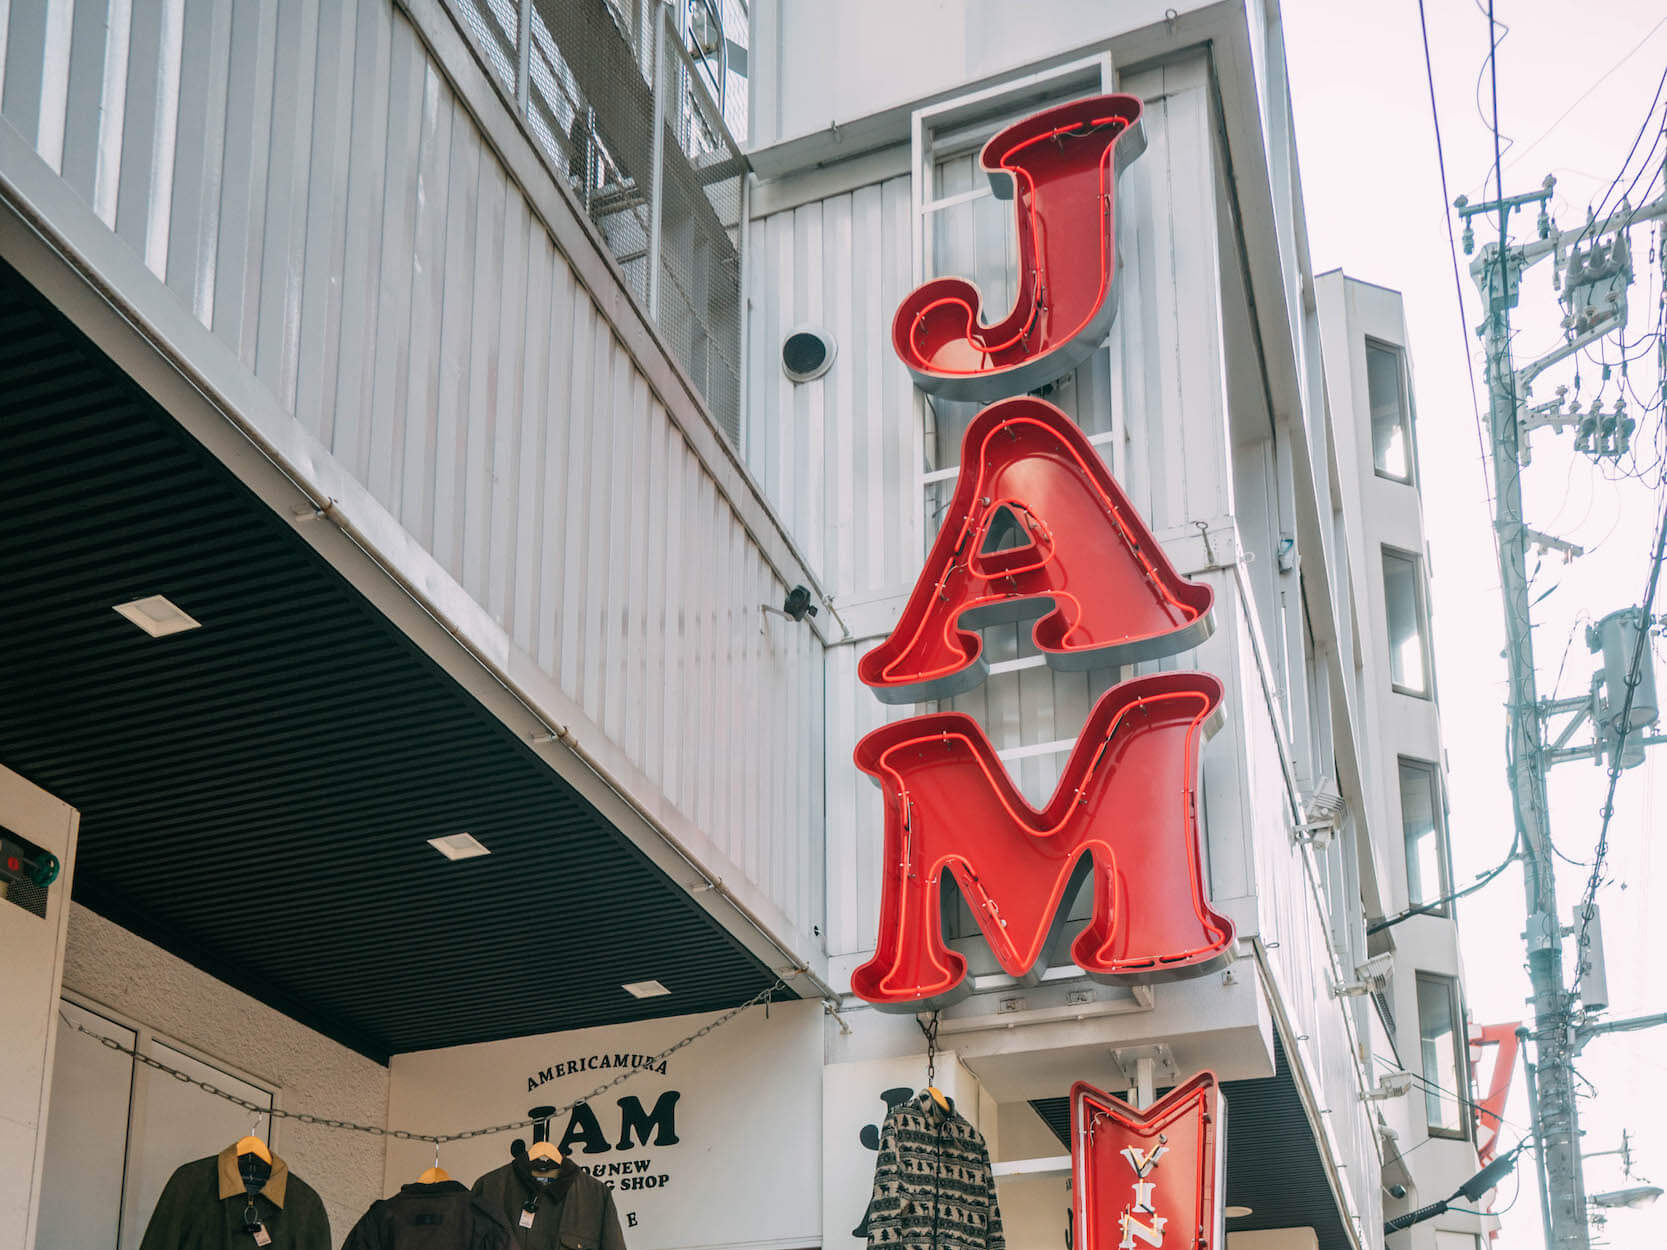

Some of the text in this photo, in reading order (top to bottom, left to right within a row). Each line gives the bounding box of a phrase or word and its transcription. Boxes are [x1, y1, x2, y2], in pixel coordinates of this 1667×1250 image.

[853, 93, 1237, 1012] JAM
[527, 1054, 668, 1092] AMERICAMURA
[510, 1090, 681, 1158] JAM
[580, 1159, 652, 1177] D&NEW
[619, 1174, 670, 1191] SHOP
